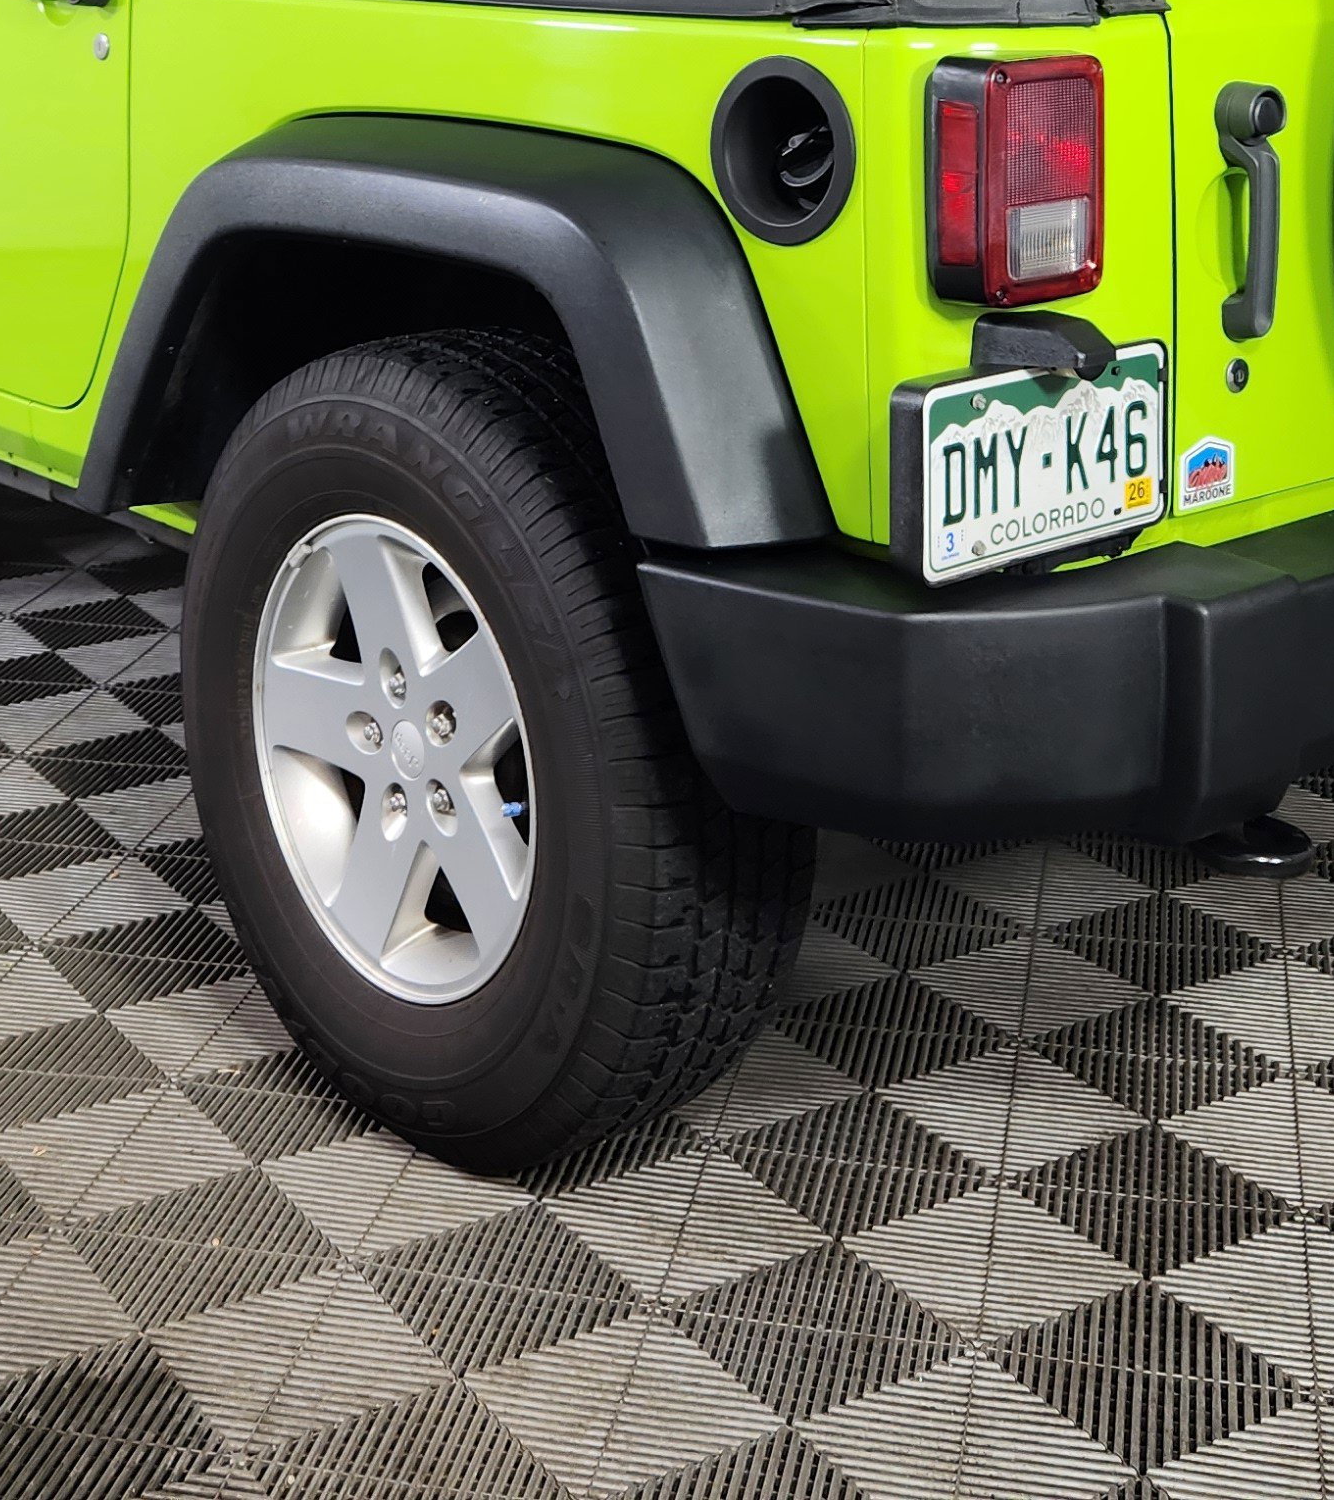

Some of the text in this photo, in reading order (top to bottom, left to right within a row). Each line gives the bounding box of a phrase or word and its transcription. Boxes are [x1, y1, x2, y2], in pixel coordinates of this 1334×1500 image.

[1128, 481, 1145, 501] 26
[1183, 484, 1232, 506] MAROONE
[990, 497, 1105, 544] COLORADO
[946, 532, 955, 552] 3
[286, 407, 576, 703] WRANGLER
